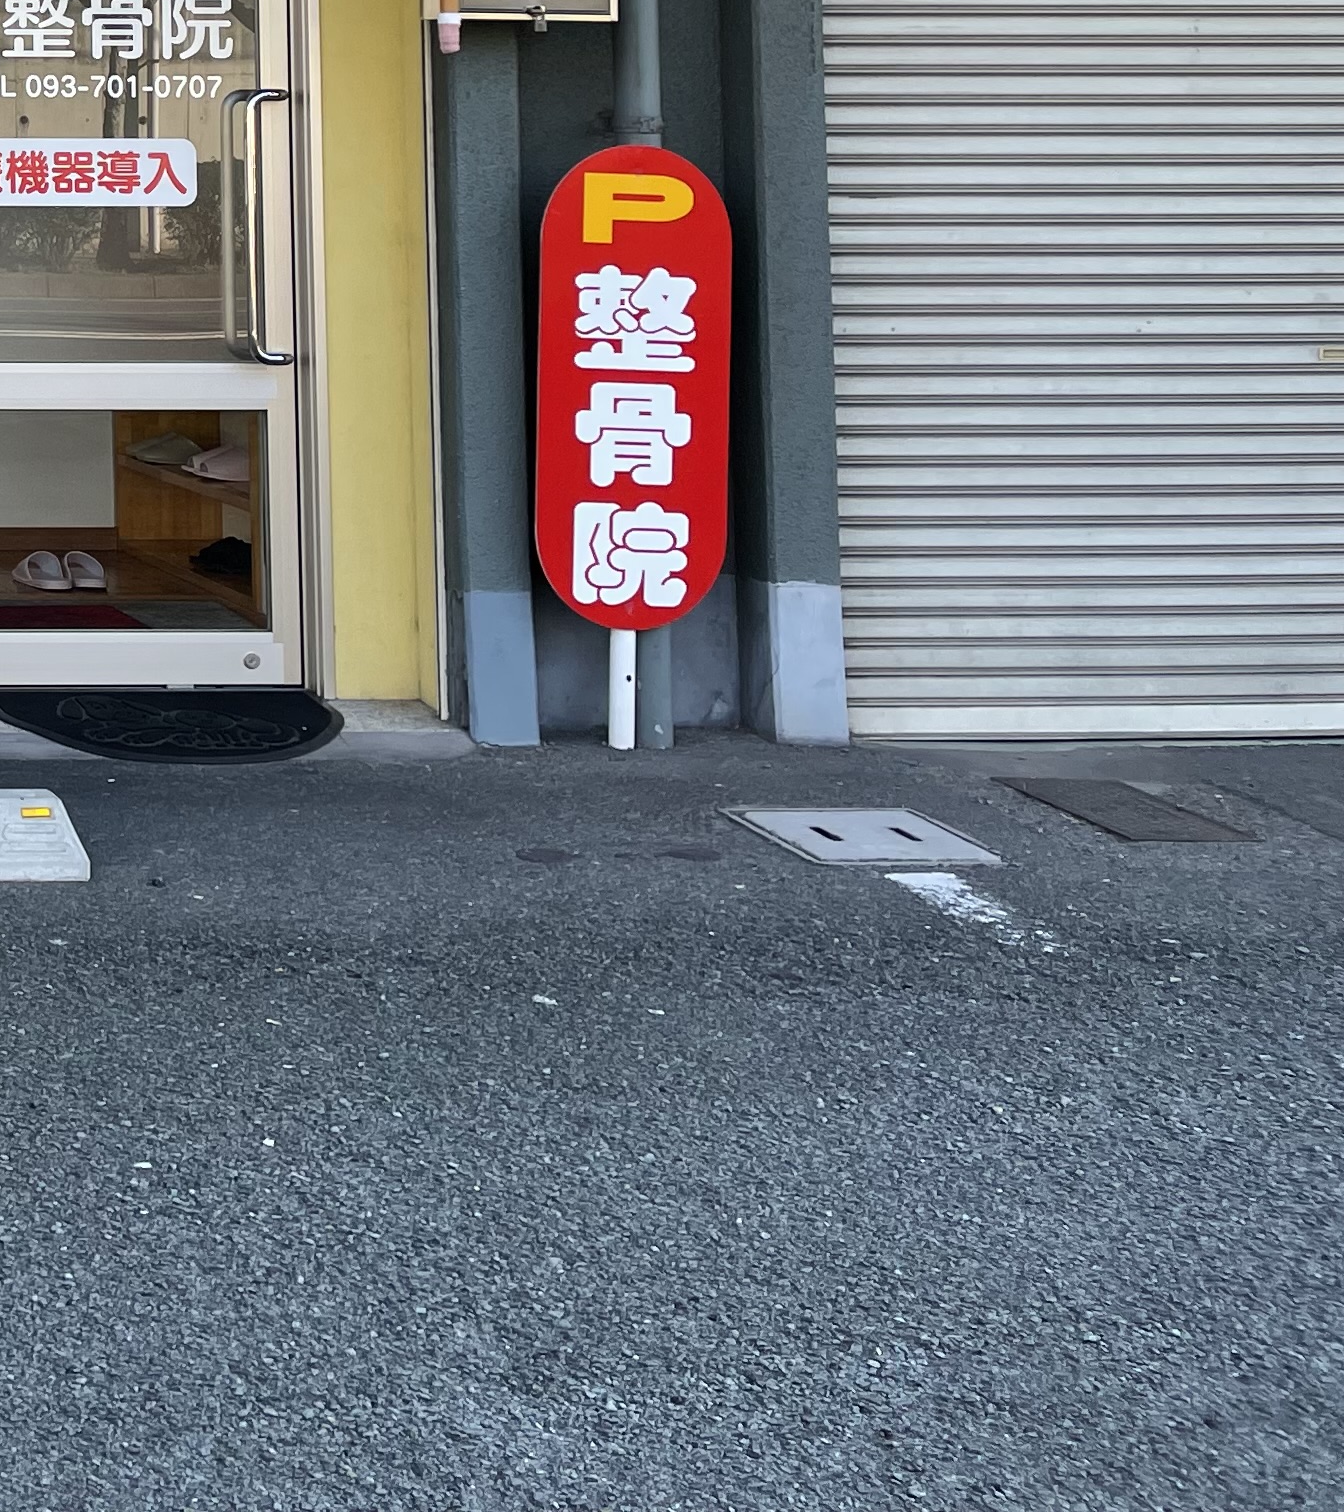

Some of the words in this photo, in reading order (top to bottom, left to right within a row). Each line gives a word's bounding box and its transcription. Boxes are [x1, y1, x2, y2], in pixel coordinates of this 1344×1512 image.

[25, 75, 223, 99] 093-701-0707
[582, 171, 695, 244] P
[572, 264, 697, 609] 整骨院
